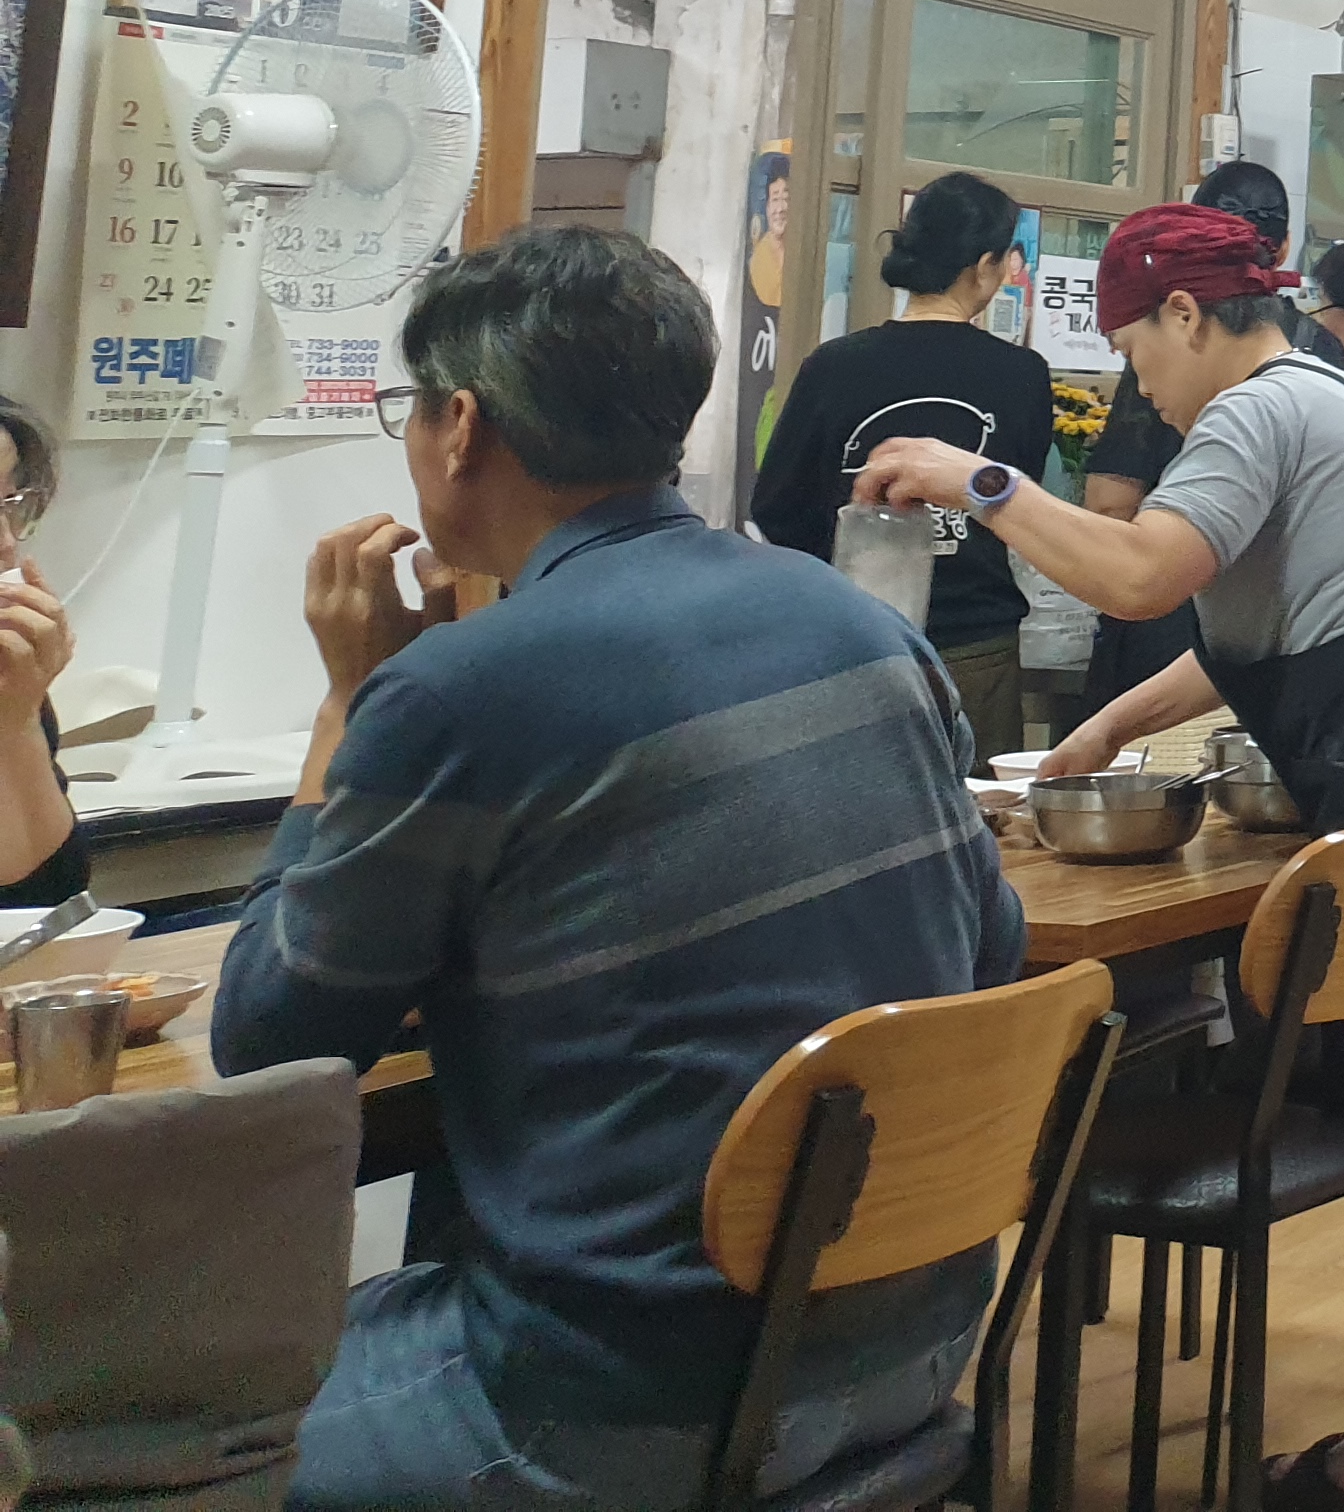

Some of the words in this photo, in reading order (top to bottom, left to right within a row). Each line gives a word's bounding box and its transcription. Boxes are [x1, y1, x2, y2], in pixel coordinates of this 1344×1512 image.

[122, 100, 139, 127] 2
[118, 158, 134, 184] 9
[155, 161, 184, 188] 10
[107, 216, 136, 244] 16
[150, 219, 179, 245] 17
[142, 275, 174, 302] 24
[311, 283, 336, 307] 31
[1041, 276, 1097, 312] 콩국
[305, 352, 378, 363] 734-9000
[307, 339, 379, 350] 733-9000
[305, 366, 375, 377] 744-3031
